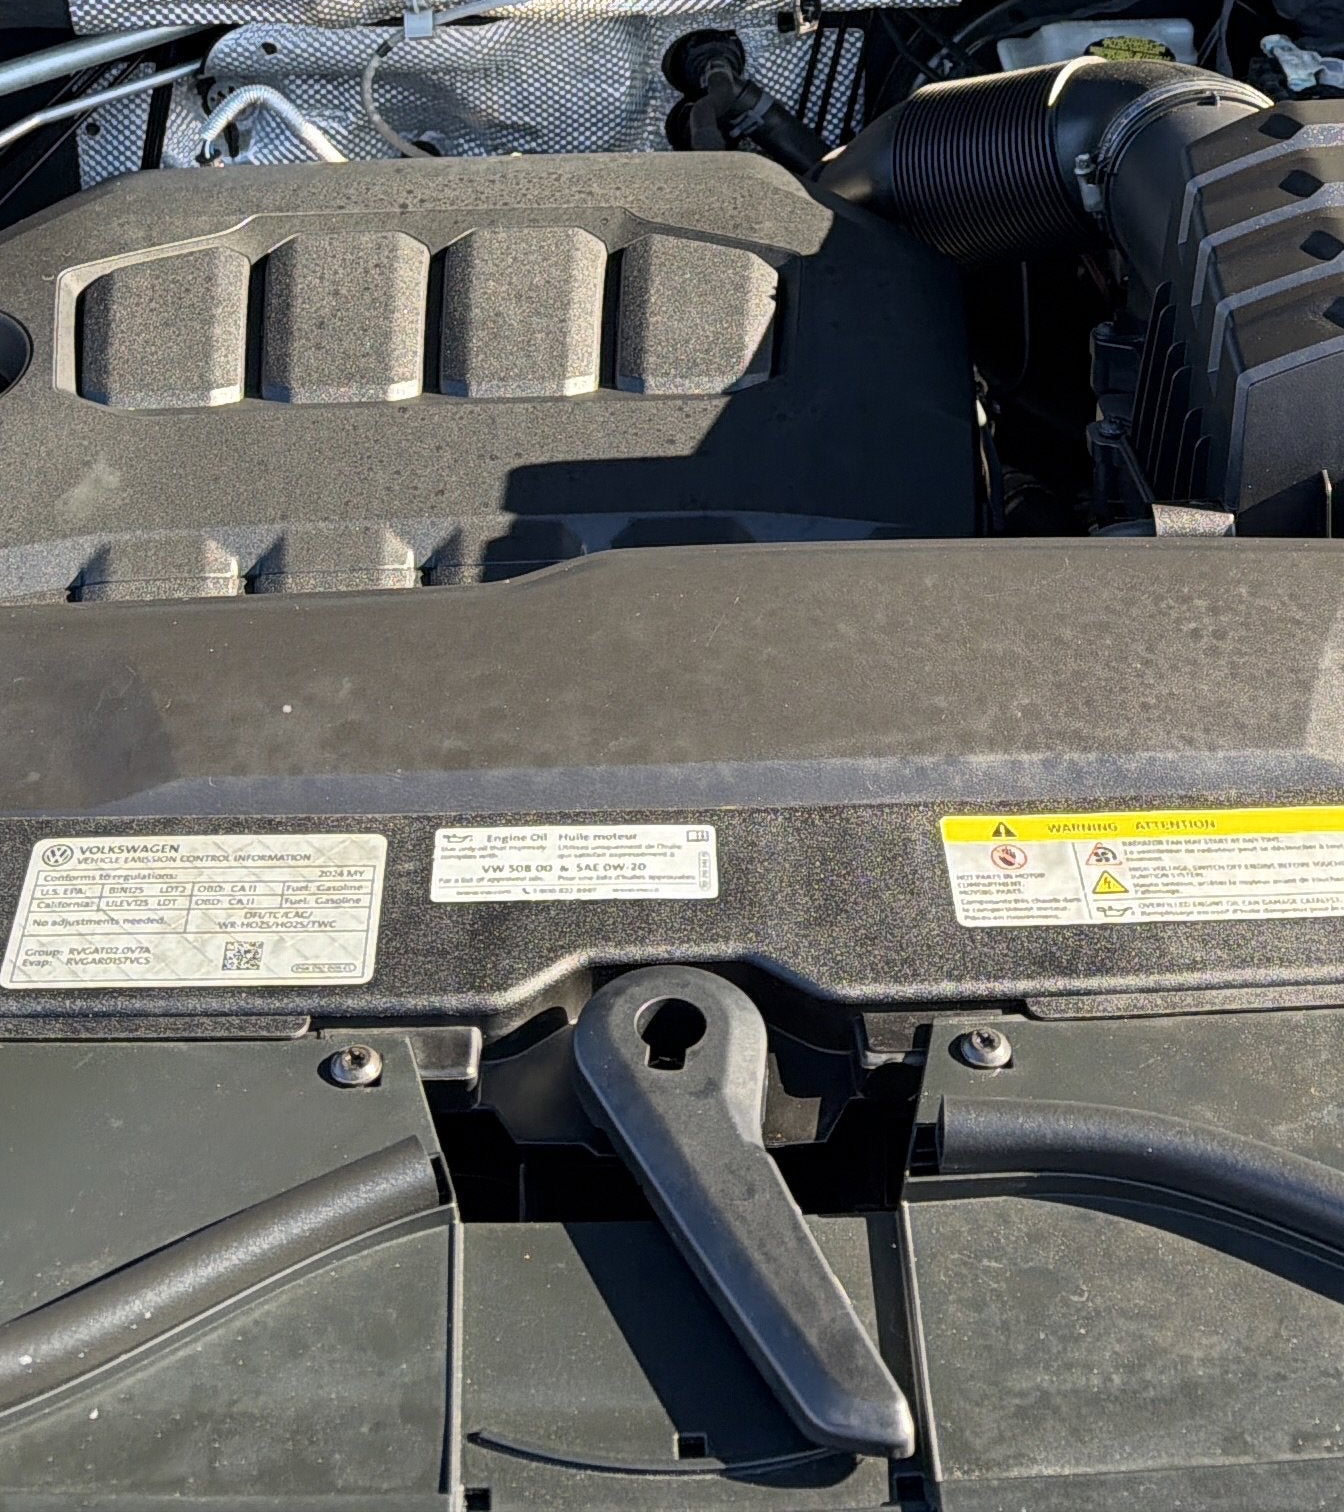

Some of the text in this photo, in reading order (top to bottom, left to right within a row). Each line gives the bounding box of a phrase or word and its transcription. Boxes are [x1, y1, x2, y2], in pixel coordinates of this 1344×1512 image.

[1047, 819, 1216, 833] WARNING ATTENTION
[486, 832, 548, 845] Engine Oil
[557, 832, 638, 842] Huile moteur
[78, 844, 181, 855] VOLKSWAGEN
[76, 853, 312, 865] VEHICLE EMISSION CONTROL INFORMATION
[481, 864, 505, 874] VW
[508, 863, 532, 873] 508
[535, 863, 553, 873] 00
[575, 862, 600, 872] SAE
[43, 874, 96, 883] Conforms
[98, 873, 111, 881] to
[317, 869, 345, 878] 2024
[345, 869, 366, 878] MY
[40, 888, 61, 897] U.S.
[159, 885, 187, 894] LDT2
[196, 884, 226, 893] OBD:
[285, 883, 312, 892] Fuel:
[315, 883, 364, 892] Gasoline
[156, 898, 178, 907] LDT
[284, 897, 309, 906] Fuel:
[314, 896, 362, 905] Gasoline
[32, 916, 167, 929] No adjustments needed.
[24, 948, 64, 958] Group:
[21, 958, 53, 968] Evap:
